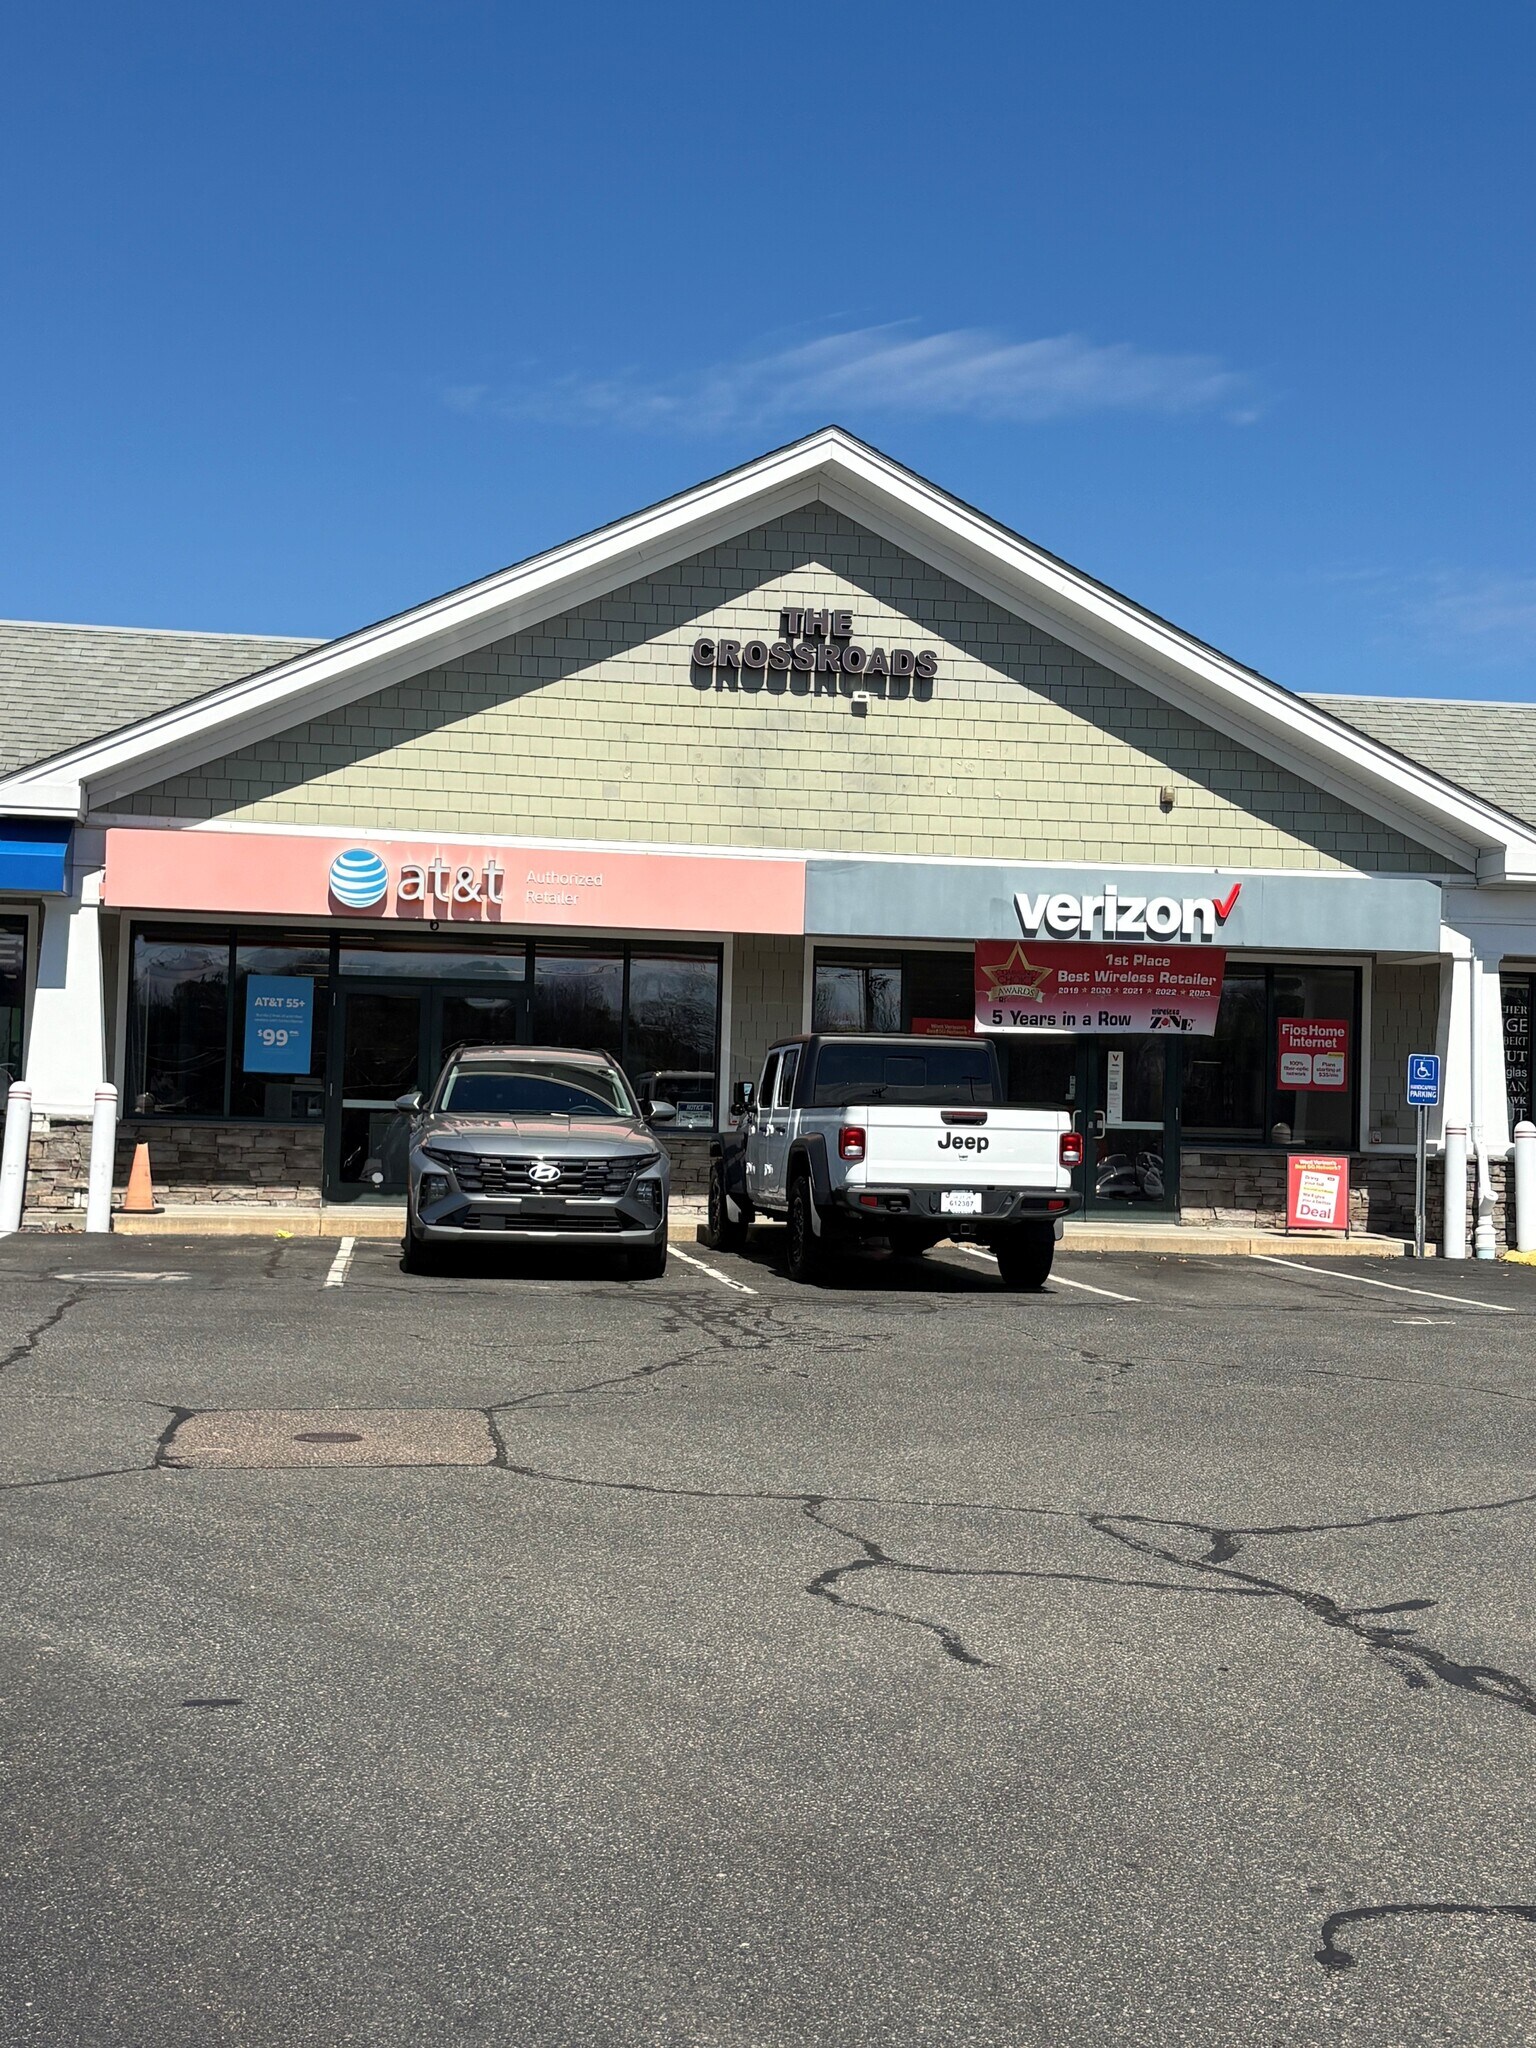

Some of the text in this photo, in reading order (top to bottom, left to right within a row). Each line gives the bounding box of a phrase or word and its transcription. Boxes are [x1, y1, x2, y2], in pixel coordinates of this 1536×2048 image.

[782, 606, 853, 637] THE
[692, 638, 938, 678] CROSSROADS
[397, 857, 504, 904] at&t
[526, 870, 603, 886] Authorized
[526, 891, 580, 905] Retailer
[1015, 884, 1216, 934] verizon
[1105, 953, 1171, 967] 1st Place
[1057, 970, 1217, 986] Best Wireless Retailer
[998, 986, 1036, 997] AWARDS
[1058, 986, 1079, 994] 2019
[1090, 987, 1112, 995] 2020
[1122, 987, 1143, 995] 2021
[1155, 988, 1177, 996] 2022
[255, 997, 306, 1008] AT&T 55+
[992, 1010, 1132, 1026] 5 Years in a Row
[257, 1029, 289, 1046] $99
[1282, 1023, 1345, 1037] Fios Home
[1289, 1036, 1337, 1048] Internet
[1410, 1090, 1437, 1099] PARKING
[937, 1132, 989, 1153] Jeep
[1300, 1204, 1331, 1218] Deal
